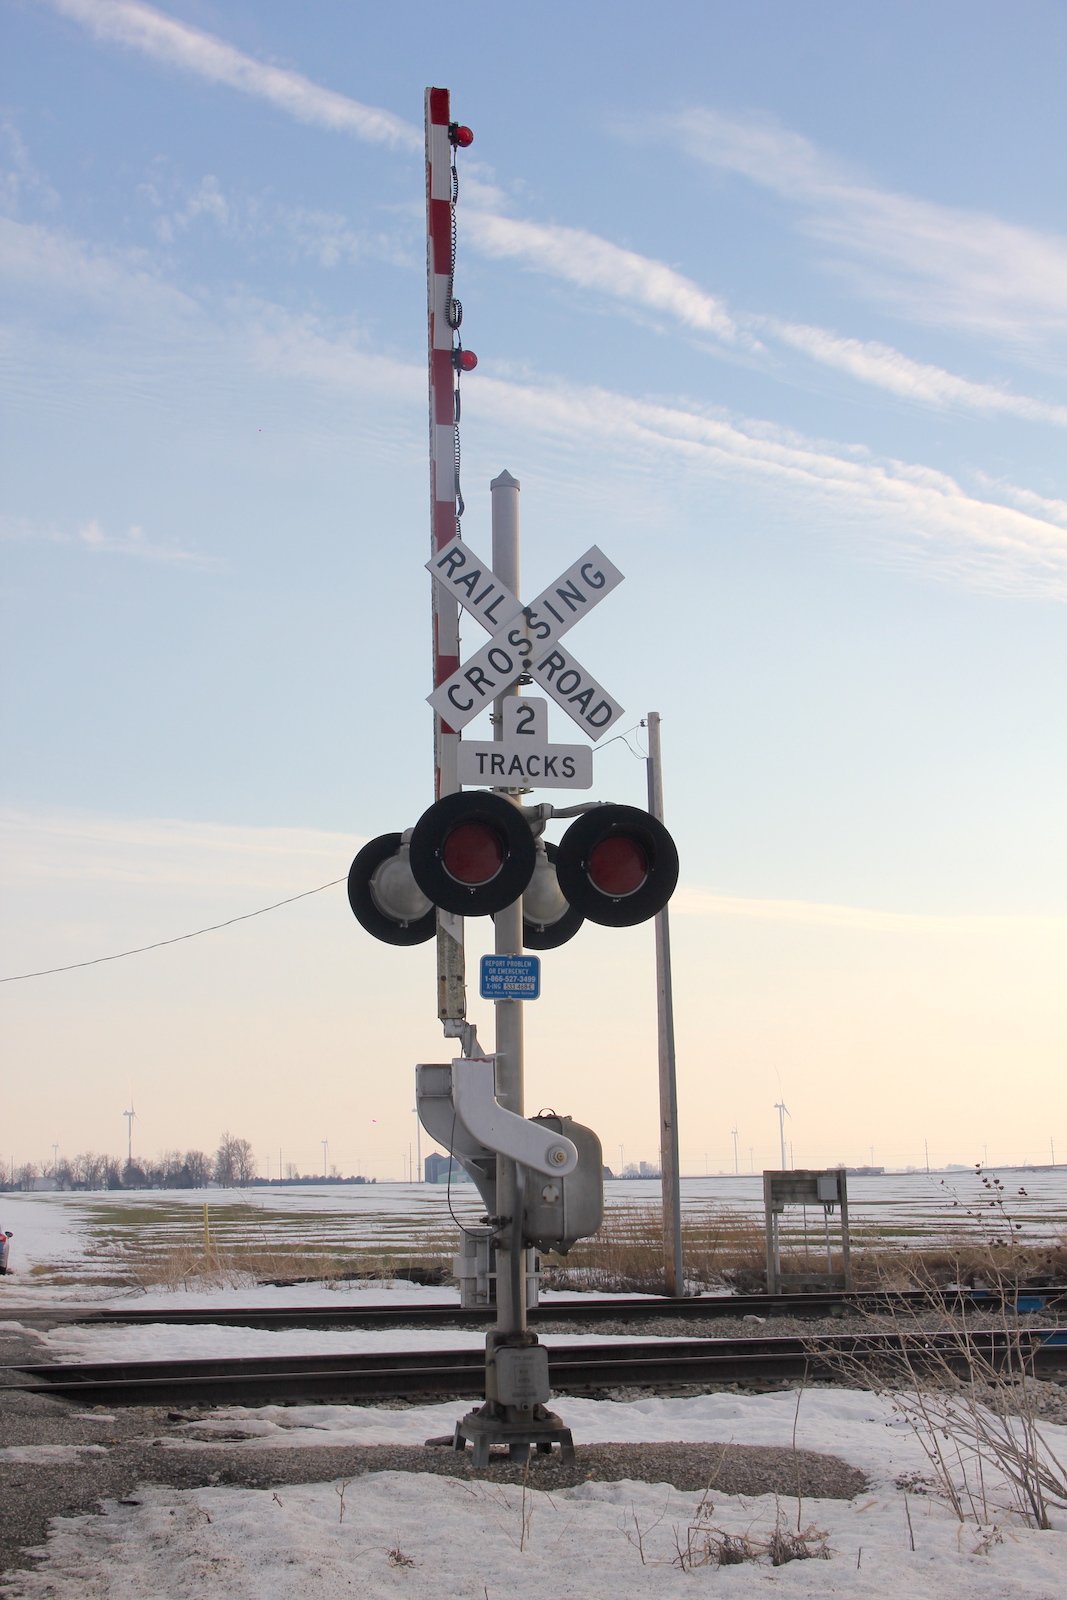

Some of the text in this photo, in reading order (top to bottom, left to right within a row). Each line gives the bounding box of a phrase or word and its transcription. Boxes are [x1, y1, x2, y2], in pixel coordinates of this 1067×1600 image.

[437, 546, 612, 728] RAIL ROAD
[447, 562, 606, 712] CROSSING
[475, 752, 576, 778] TRACKS
[516, 706, 536, 735] 2
